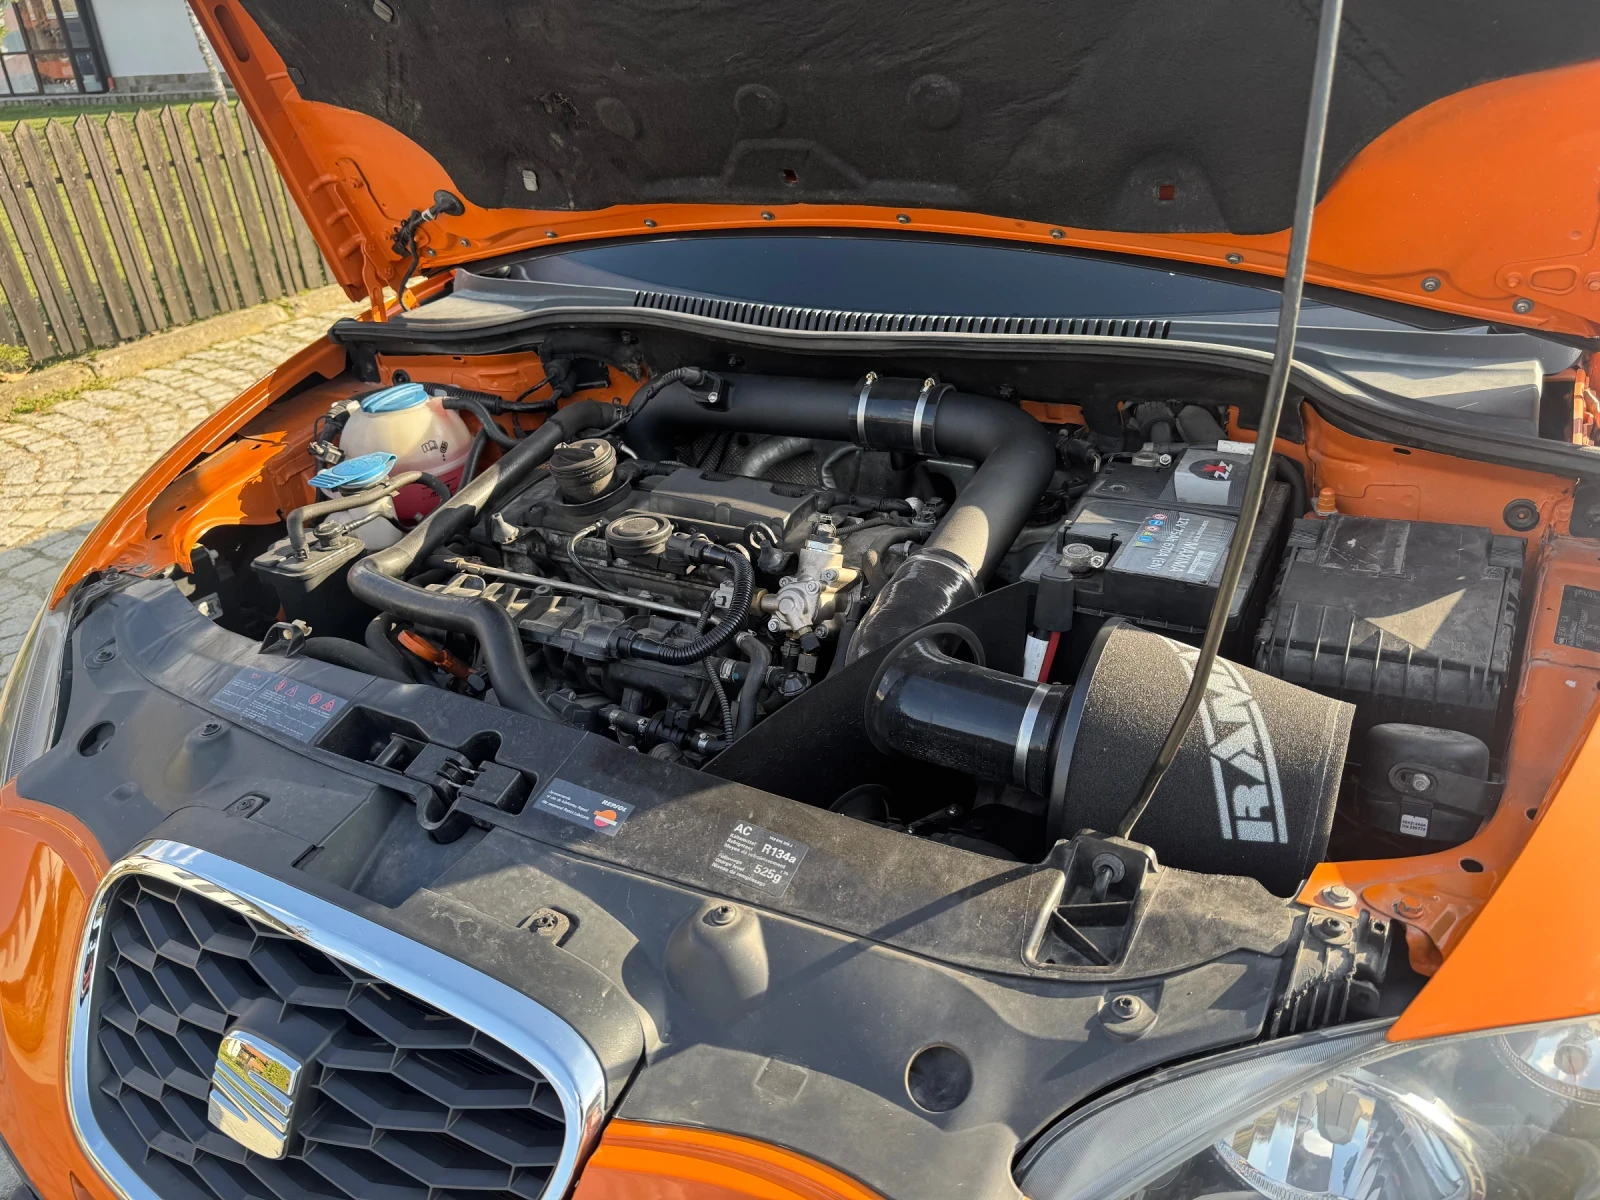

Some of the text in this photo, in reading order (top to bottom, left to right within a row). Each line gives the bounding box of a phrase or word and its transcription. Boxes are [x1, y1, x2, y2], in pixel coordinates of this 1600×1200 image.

[1168, 541, 1199, 572] MAXIMA
[601, 799, 628, 813] REPSOL
[733, 823, 753, 836] AC
[761, 843, 797, 864] R134a
[753, 864, 782, 884] 525g
